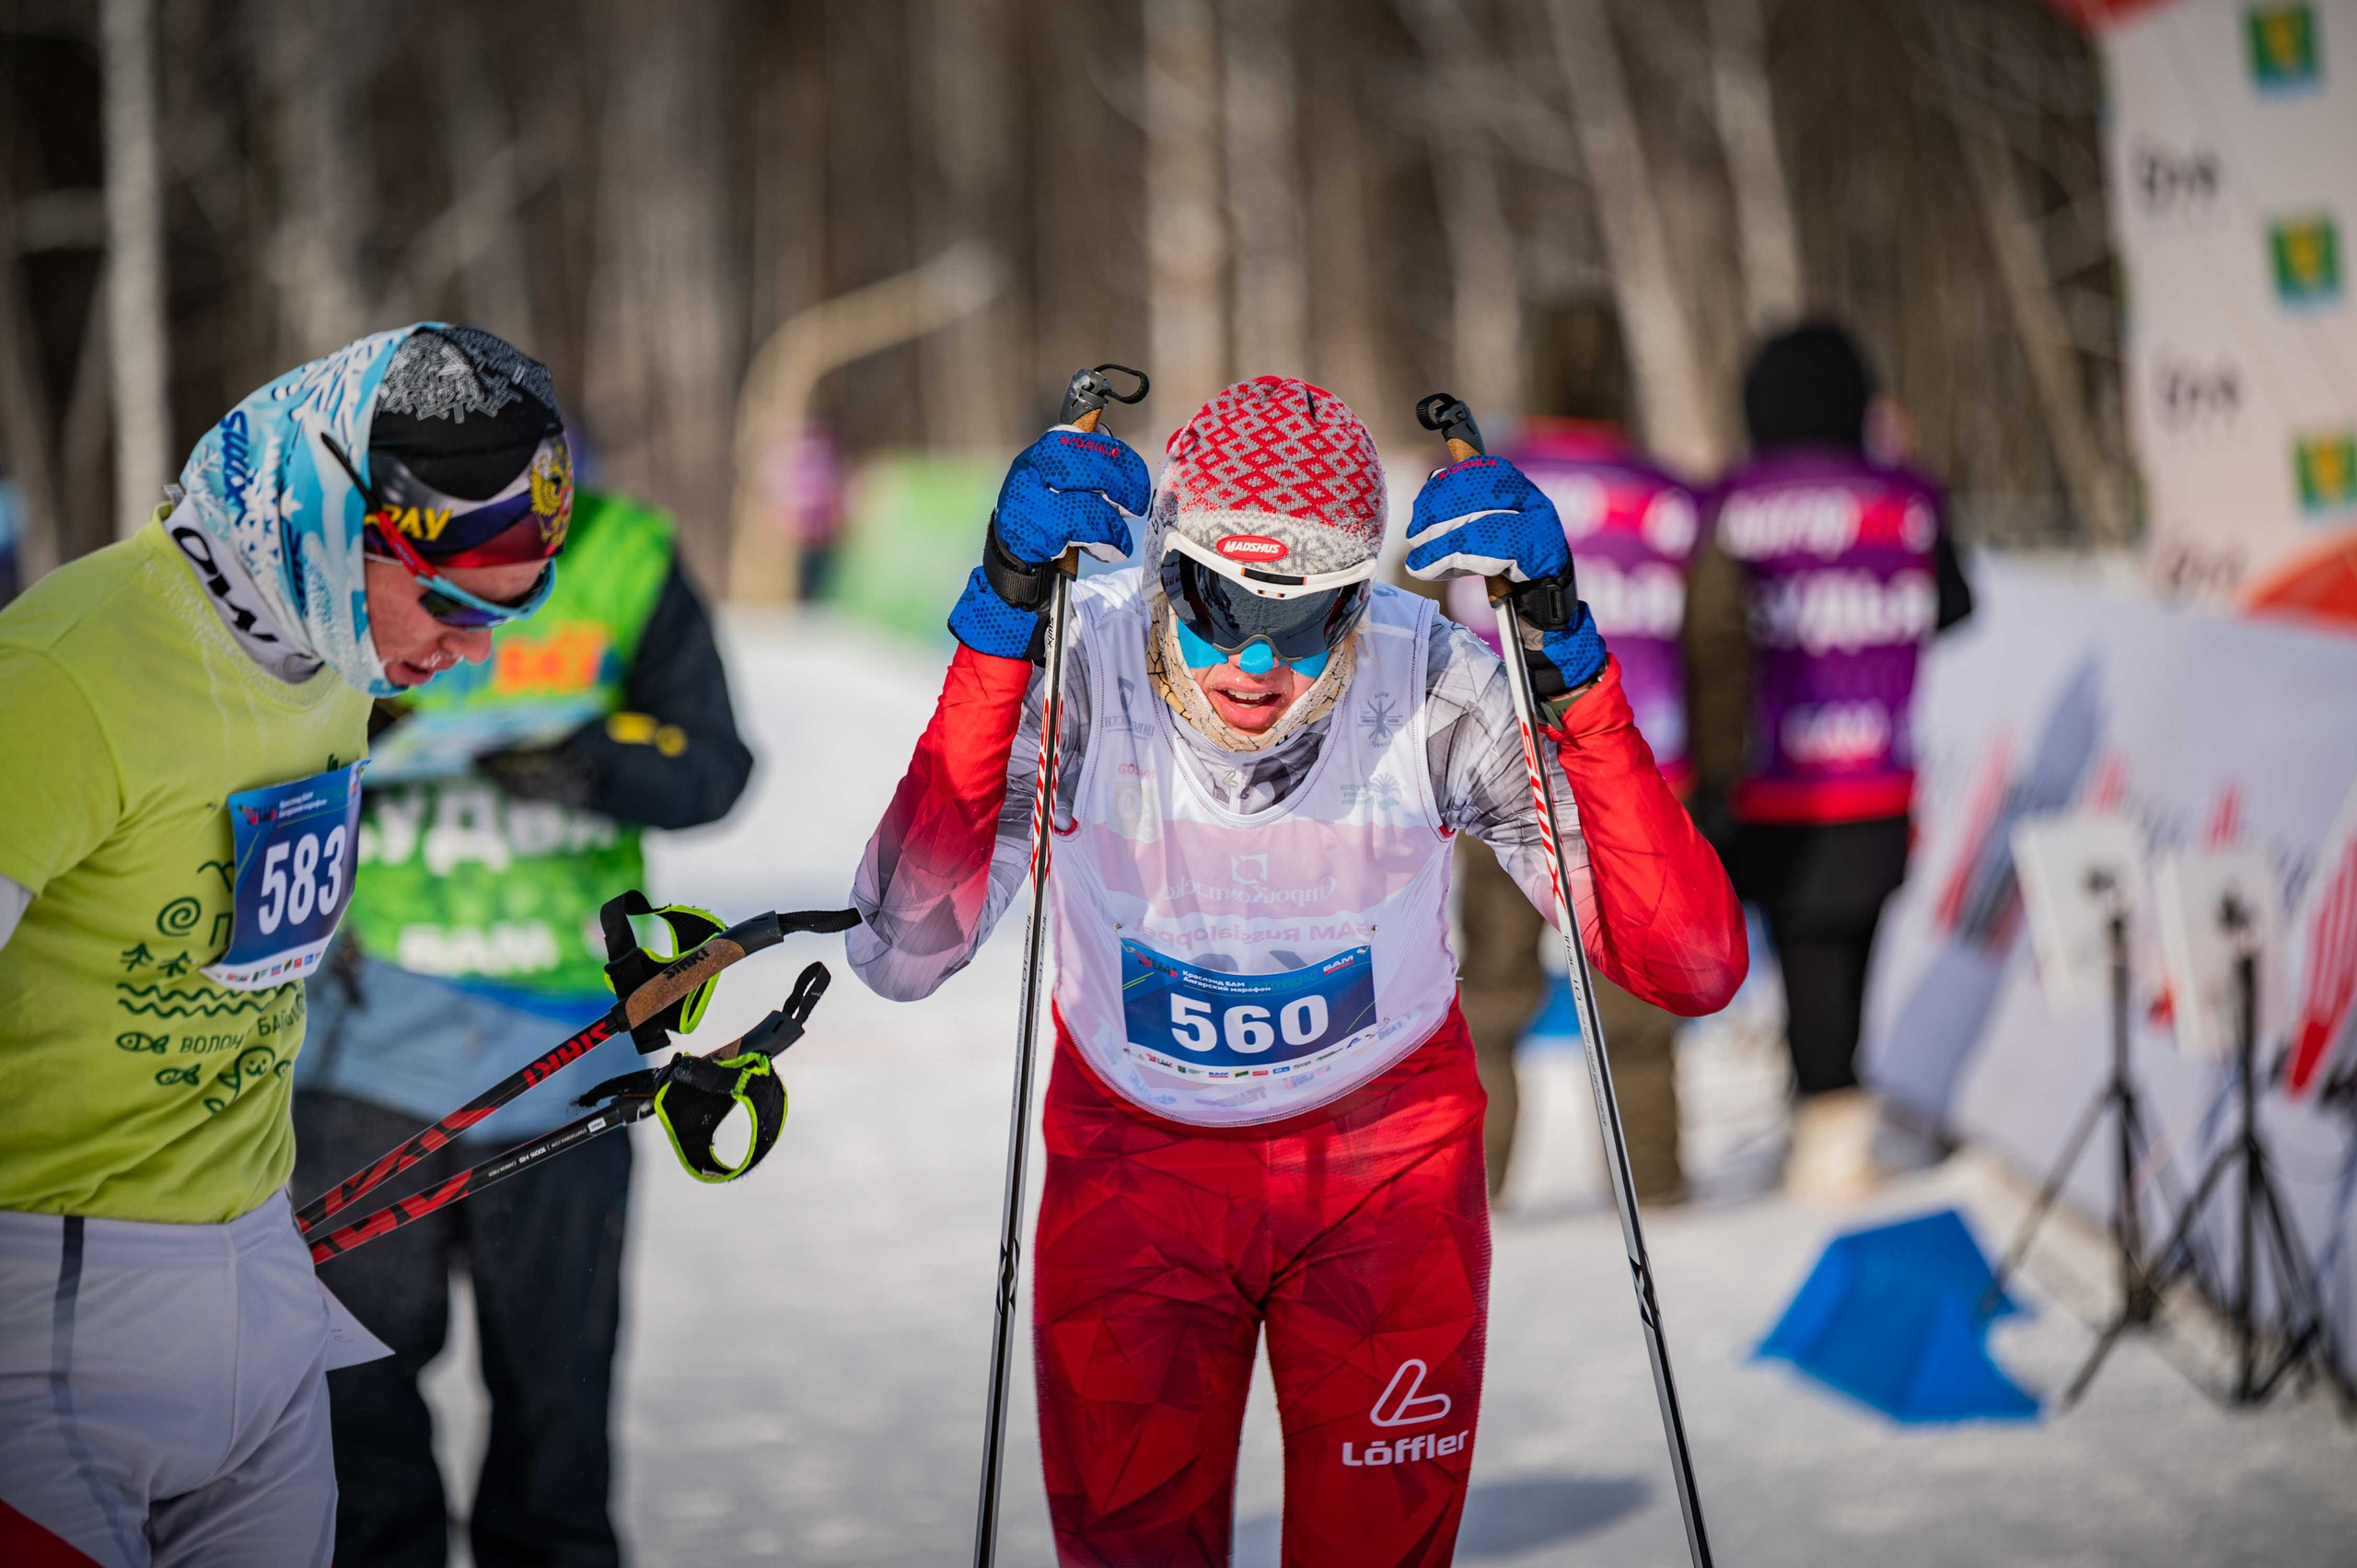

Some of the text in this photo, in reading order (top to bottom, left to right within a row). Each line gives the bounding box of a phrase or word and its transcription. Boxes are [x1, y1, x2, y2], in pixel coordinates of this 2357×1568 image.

[1222, 540, 1281, 554] MADSHUS
[258, 824, 347, 935] 583
[663, 947, 711, 981] START
[1170, 993, 1329, 1054] 560
